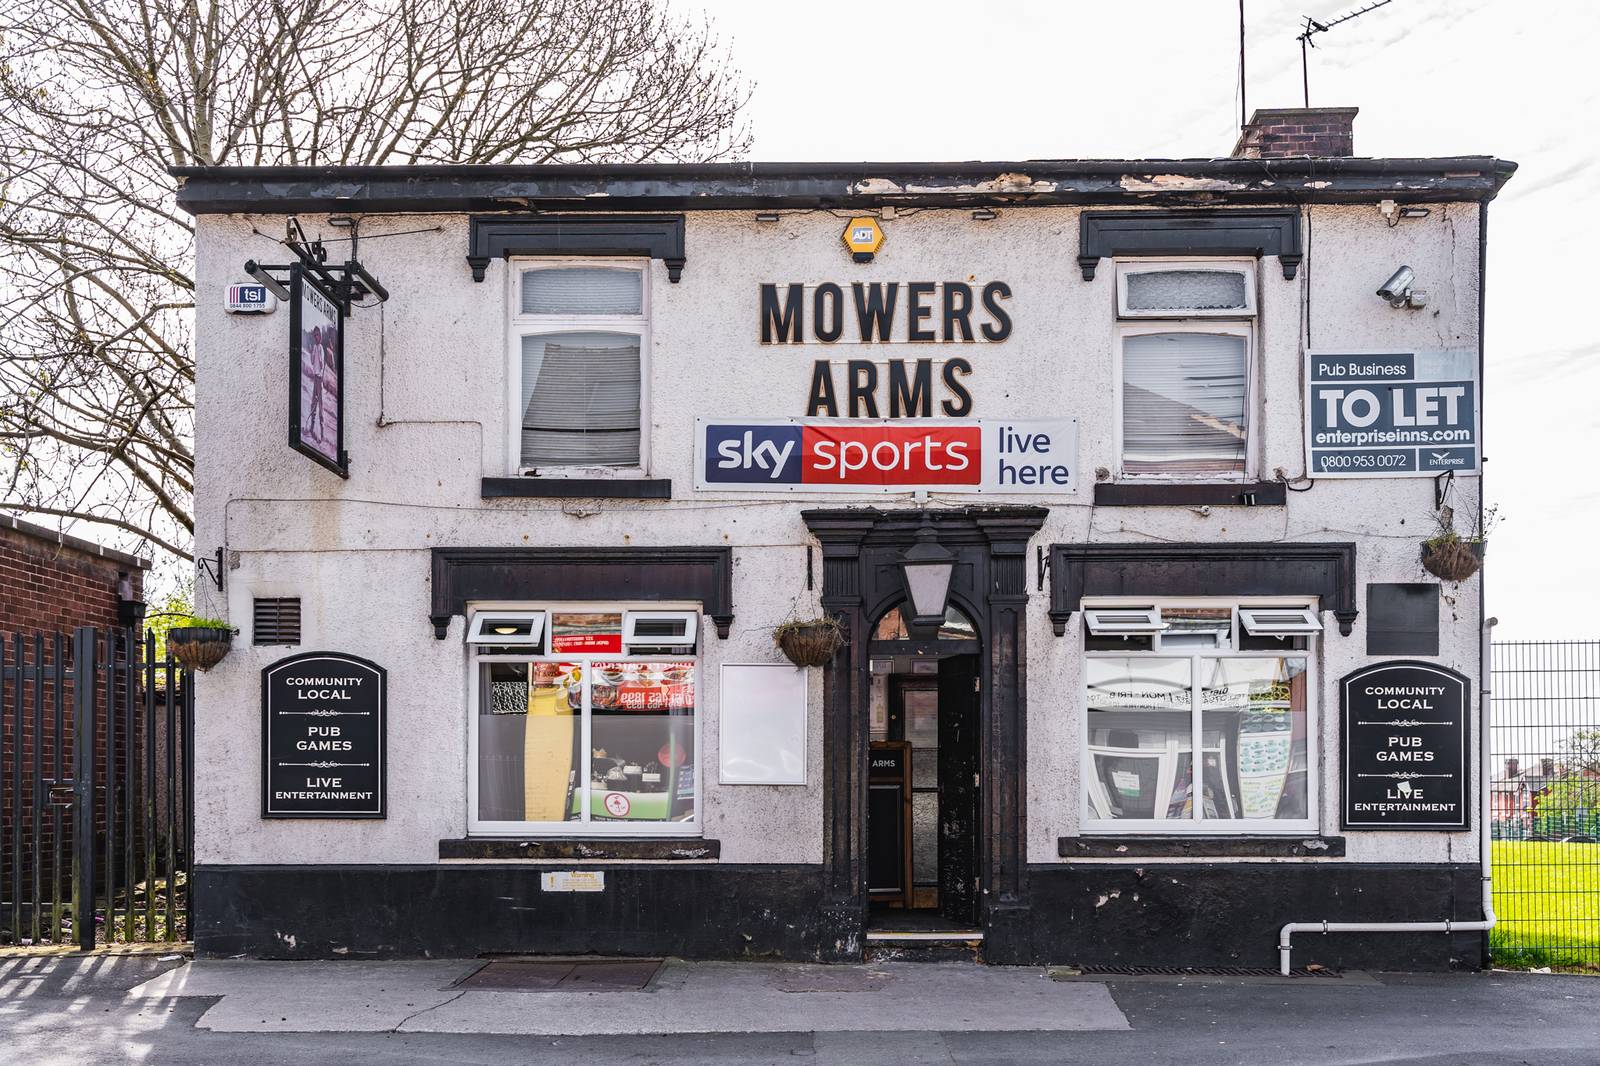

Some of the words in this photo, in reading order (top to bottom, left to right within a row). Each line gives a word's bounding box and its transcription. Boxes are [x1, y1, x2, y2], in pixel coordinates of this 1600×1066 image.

[853, 230, 873, 240] ADT
[244, 288, 261, 301] tsi
[323, 300, 336, 325] ARMS
[760, 281, 1013, 344] MOWERS
[1319, 363, 1346, 377] Pub
[1349, 362, 1407, 376] Business
[807, 357, 973, 417] ARMS
[1319, 388, 1381, 428] TO
[1392, 386, 1465, 427] LET
[999, 426, 1051, 454] live
[1315, 429, 1470, 446] enterpriseinns.com
[717, 430, 795, 478] sky
[813, 435, 969, 478] sports
[1321, 455, 1352, 468] 0800
[1353, 455, 1376, 467] 953
[1377, 454, 1407, 467] 0072
[1429, 458, 1465, 466] ENTERPRISE
[999, 459, 1069, 485] here
[286, 677, 363, 686] COMMUNITY
[298, 689, 352, 700] LOCAL
[1365, 686, 1445, 695] COMMUNITY
[1377, 699, 1433, 709] LOCAL
[308, 726, 341, 737] PUB
[296, 740, 352, 751] GAMES
[1388, 736, 1422, 747] PUB
[1376, 751, 1434, 762] GAMES
[306, 777, 342, 788] LIVE
[275, 791, 373, 800] ENTERTAINMENT
[1387, 789, 1424, 799] LIVE
[1354, 803, 1456, 812] ENTERTAINMENT
